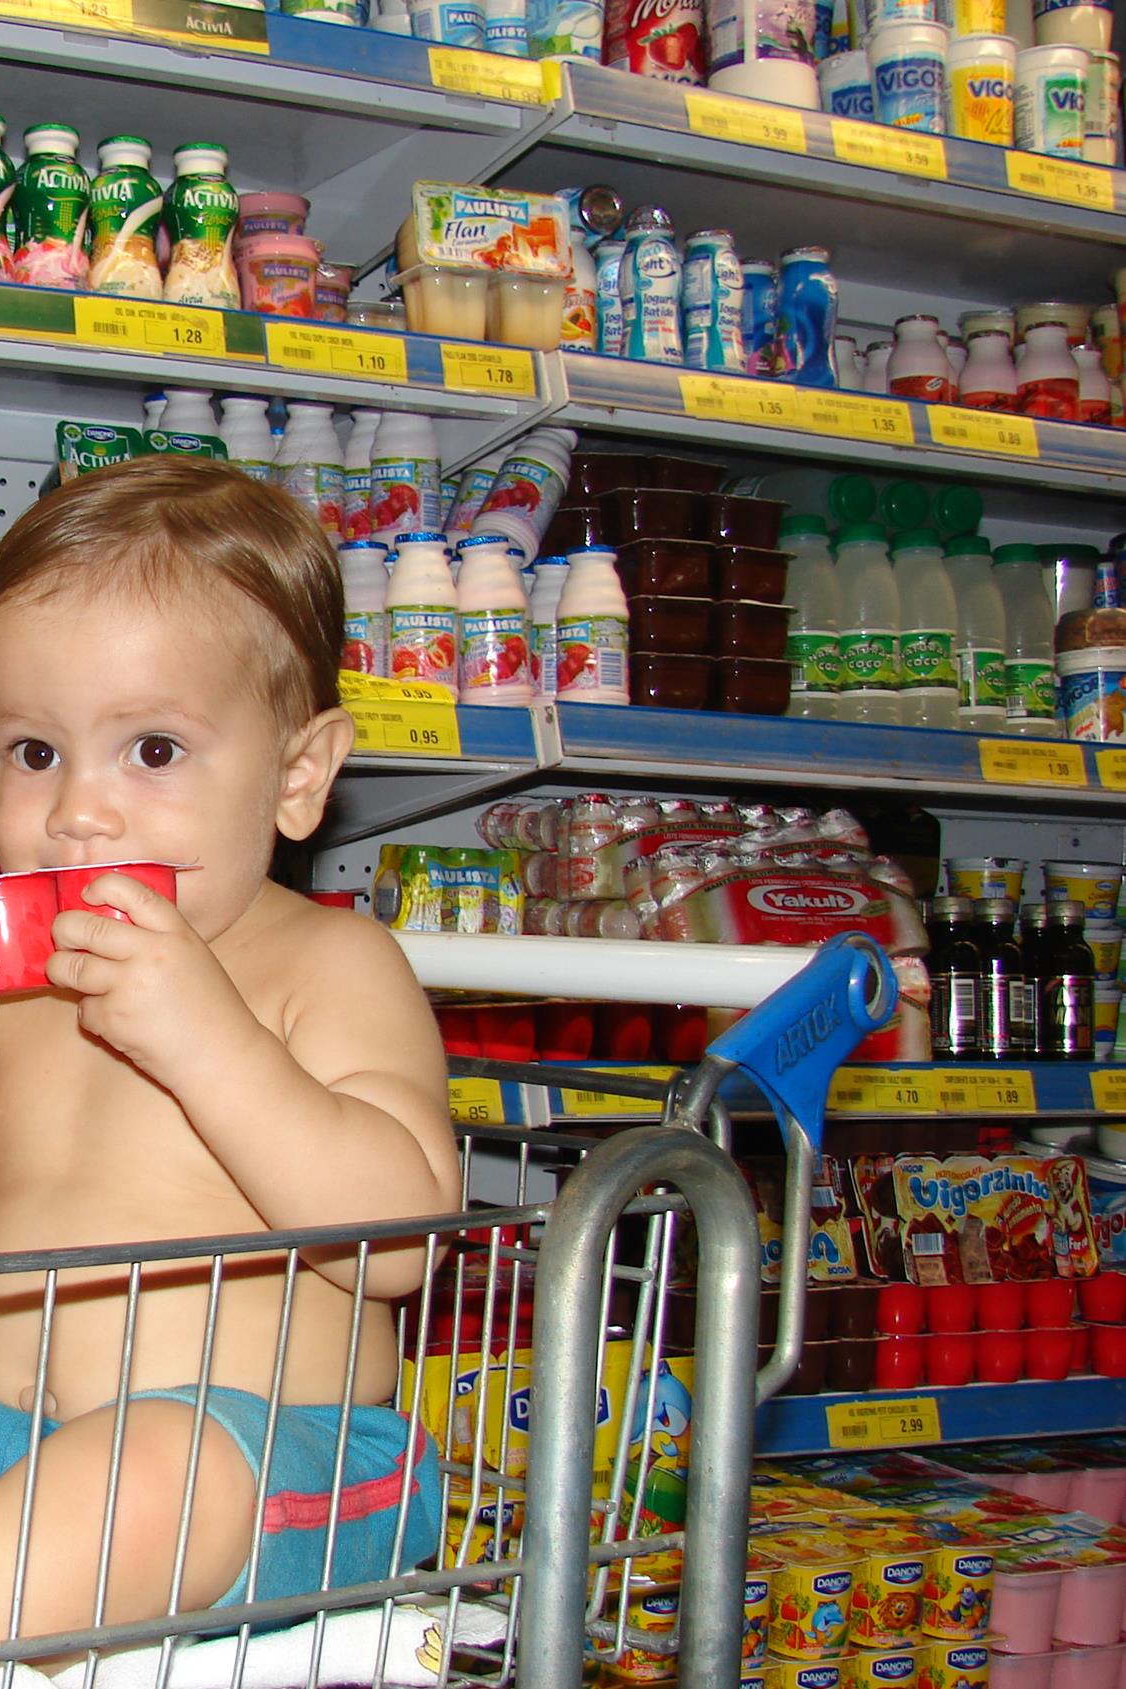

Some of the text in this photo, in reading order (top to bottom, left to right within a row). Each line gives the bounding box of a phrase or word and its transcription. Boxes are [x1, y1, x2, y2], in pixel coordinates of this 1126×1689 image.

[186, 16, 232, 35] ACTIVIA
[1052, 90, 1084, 110] VIG
[38, 168, 90, 194] ACTIVIA
[91, 182, 132, 201] TIVIA
[183, 188, 238, 211] ACTIVIA
[456, 201, 527, 220] PAULISTA
[444, 221, 486, 241] Flan
[396, 615, 453, 628] PAULISTA
[766, 892, 851, 908] Yakult
[909, 1166, 1051, 1217] Vigorzinho
[888, 1565, 923, 1580] DANONE
[959, 1558, 992, 1572] DANONE
[817, 1574, 851, 1590] DANONE
[952, 1651, 987, 1667] DANONE
[876, 1660, 914, 1676] DANONE
[802, 1671, 838, 1686] DANONE
